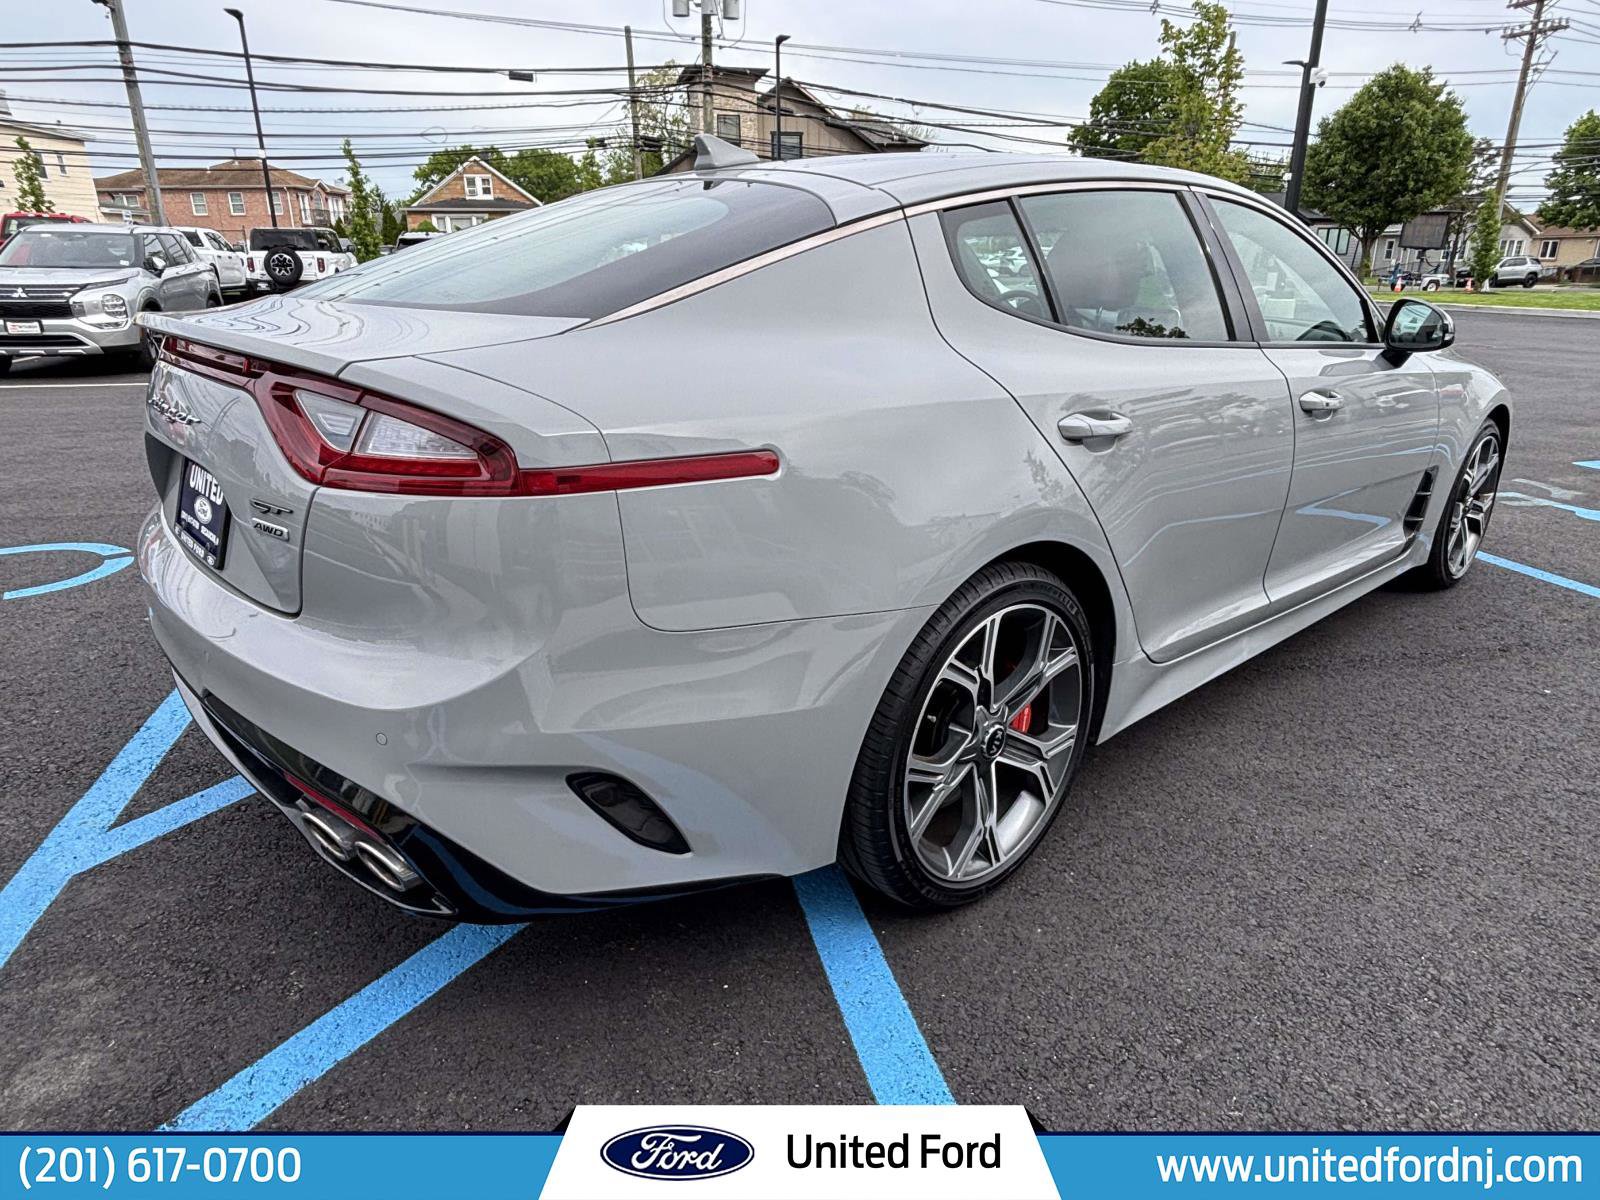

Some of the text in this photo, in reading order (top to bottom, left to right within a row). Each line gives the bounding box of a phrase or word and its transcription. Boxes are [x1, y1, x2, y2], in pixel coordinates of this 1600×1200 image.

[189, 463, 224, 505] UNITED
[253, 522, 285, 537] AWD
[989, 730, 1003, 754] KIA
